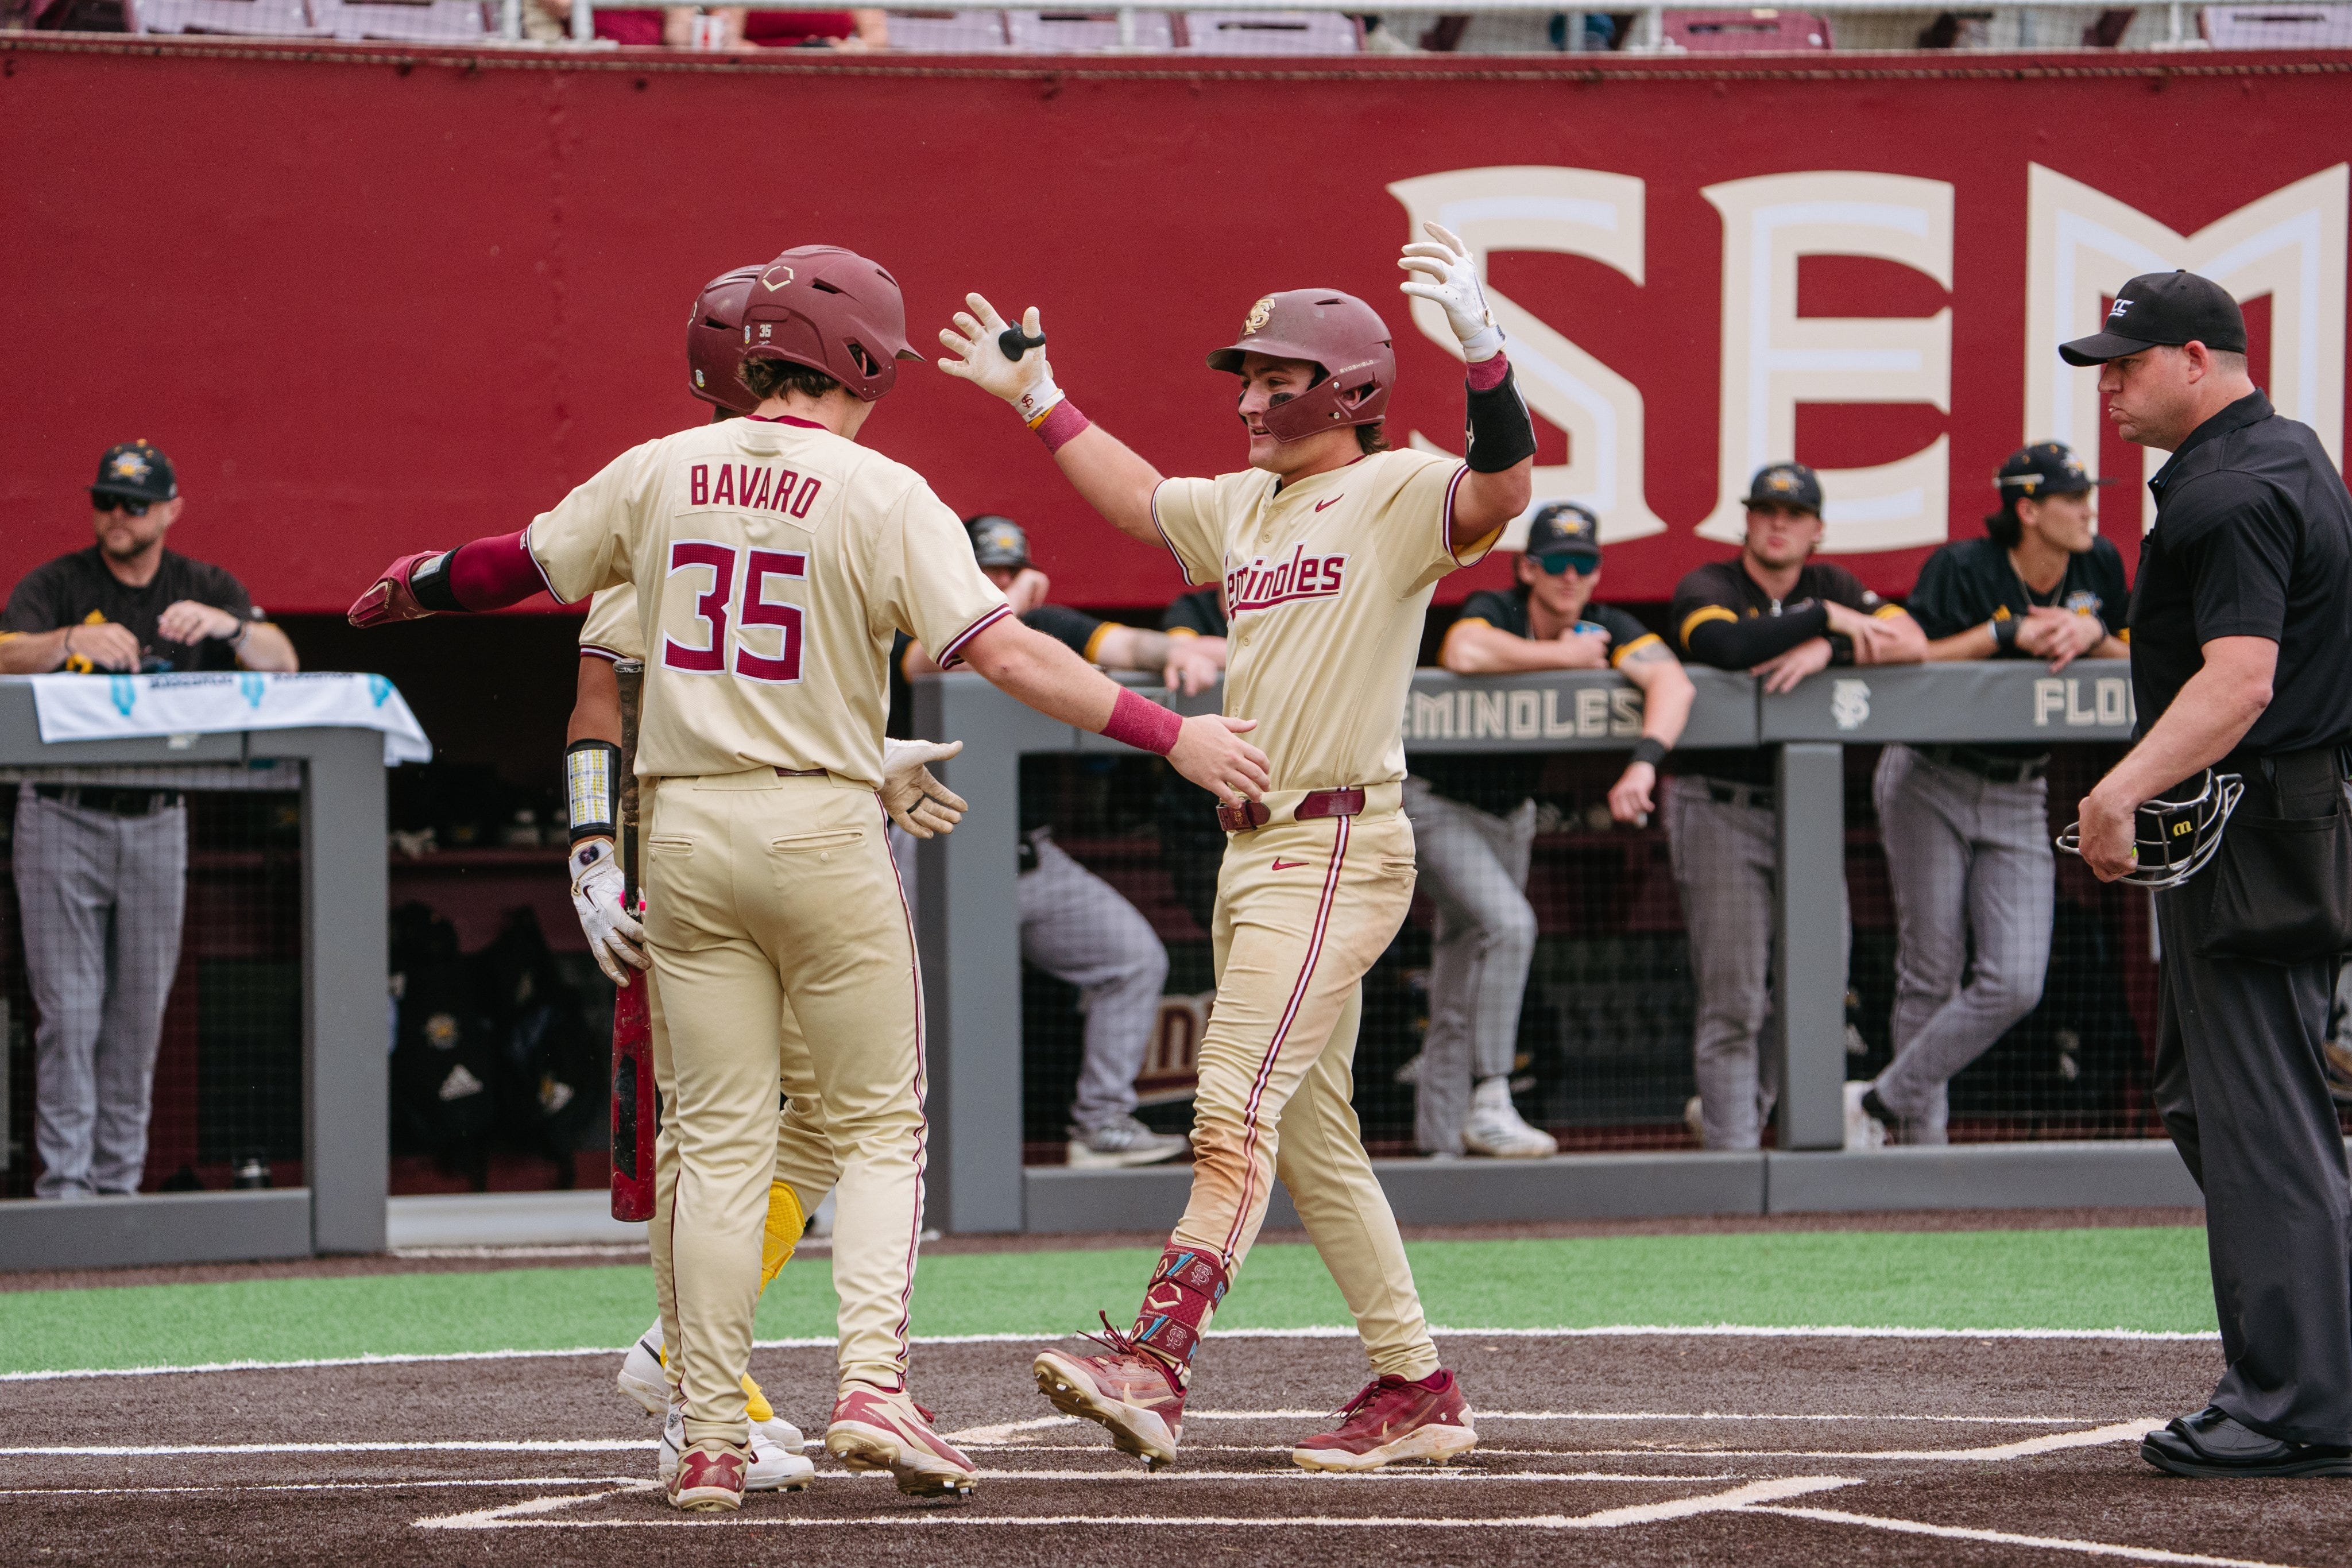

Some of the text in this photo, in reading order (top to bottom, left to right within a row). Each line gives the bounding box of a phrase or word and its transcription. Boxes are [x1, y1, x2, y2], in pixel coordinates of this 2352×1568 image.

[759, 324, 772, 337] 35
[1340, 359, 1374, 373] EVOSHIELD
[691, 464, 822, 519] BAVARO
[1223, 540, 1351, 620] eminoles
[661, 539, 810, 684] 35
[1401, 688, 1643, 739] MINOLES
